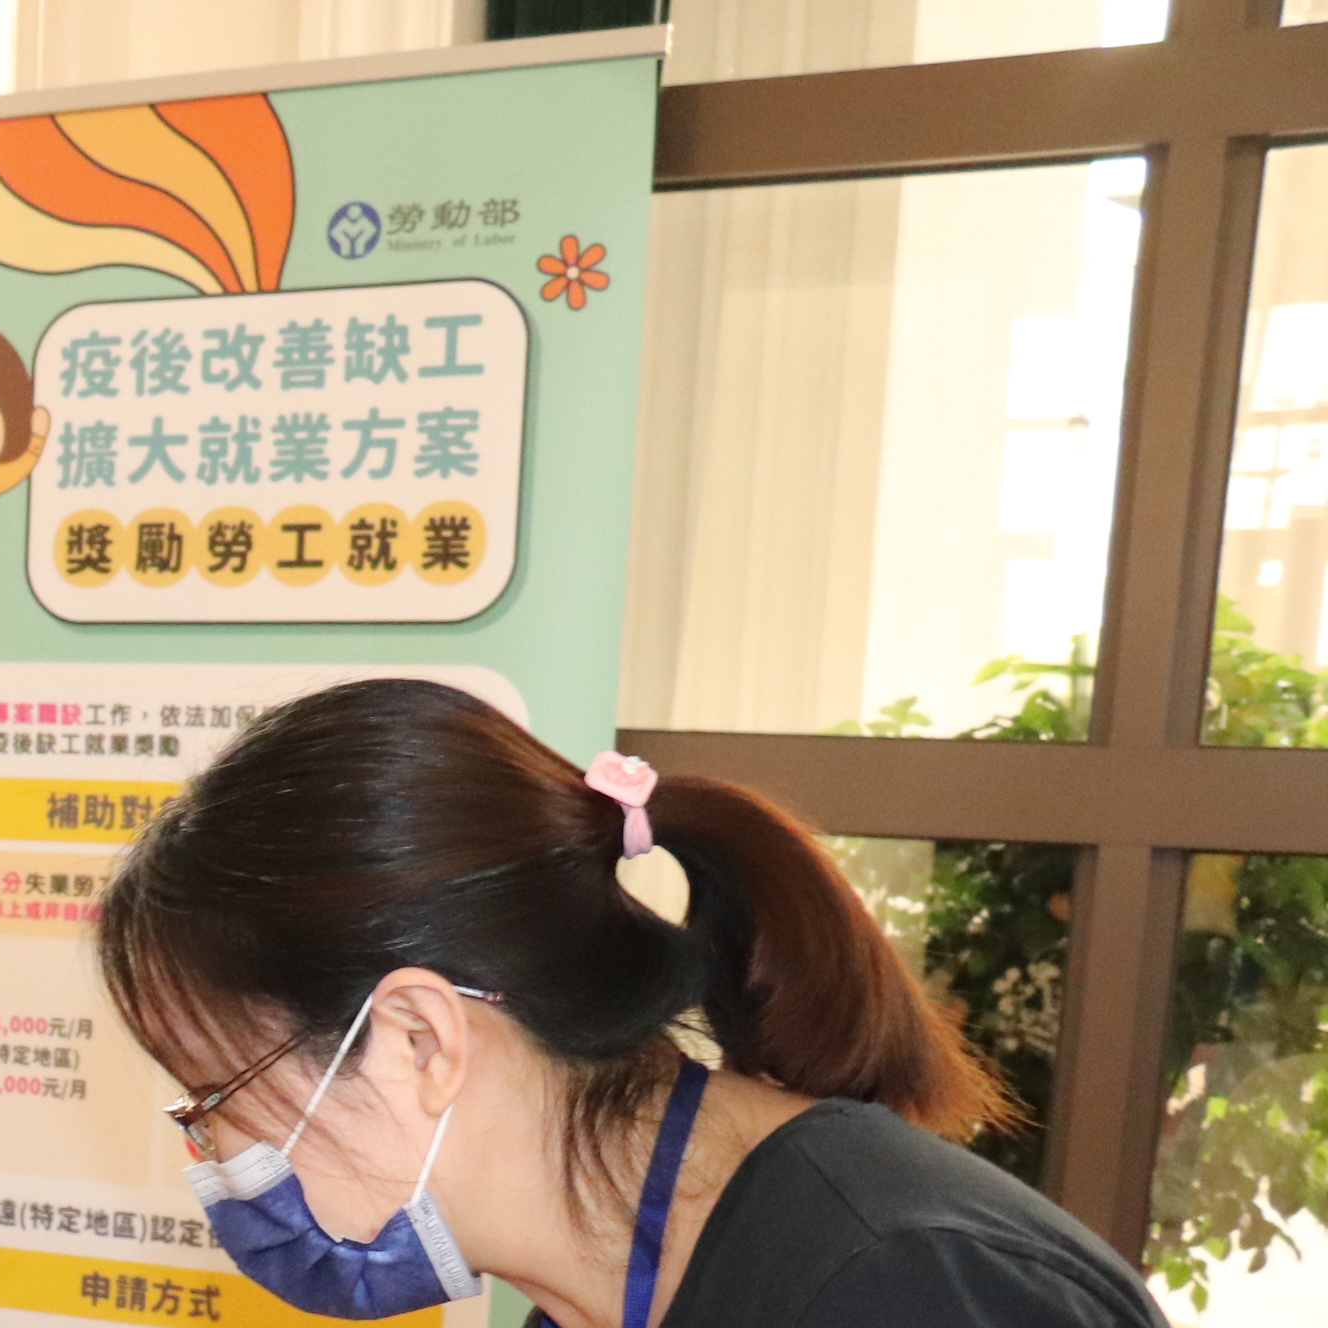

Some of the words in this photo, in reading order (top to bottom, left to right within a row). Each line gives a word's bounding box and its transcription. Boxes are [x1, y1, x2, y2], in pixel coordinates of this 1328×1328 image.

[386, 198, 520, 236] 勞動部
[60, 313, 485, 399] 疫後改善缺工
[56, 407, 481, 490] 擴大就業方案
[65, 518, 473, 576] 獎勵勞工就業
[46, 792, 177, 830] 補助對
[81, 1271, 222, 1322] 申請方式
